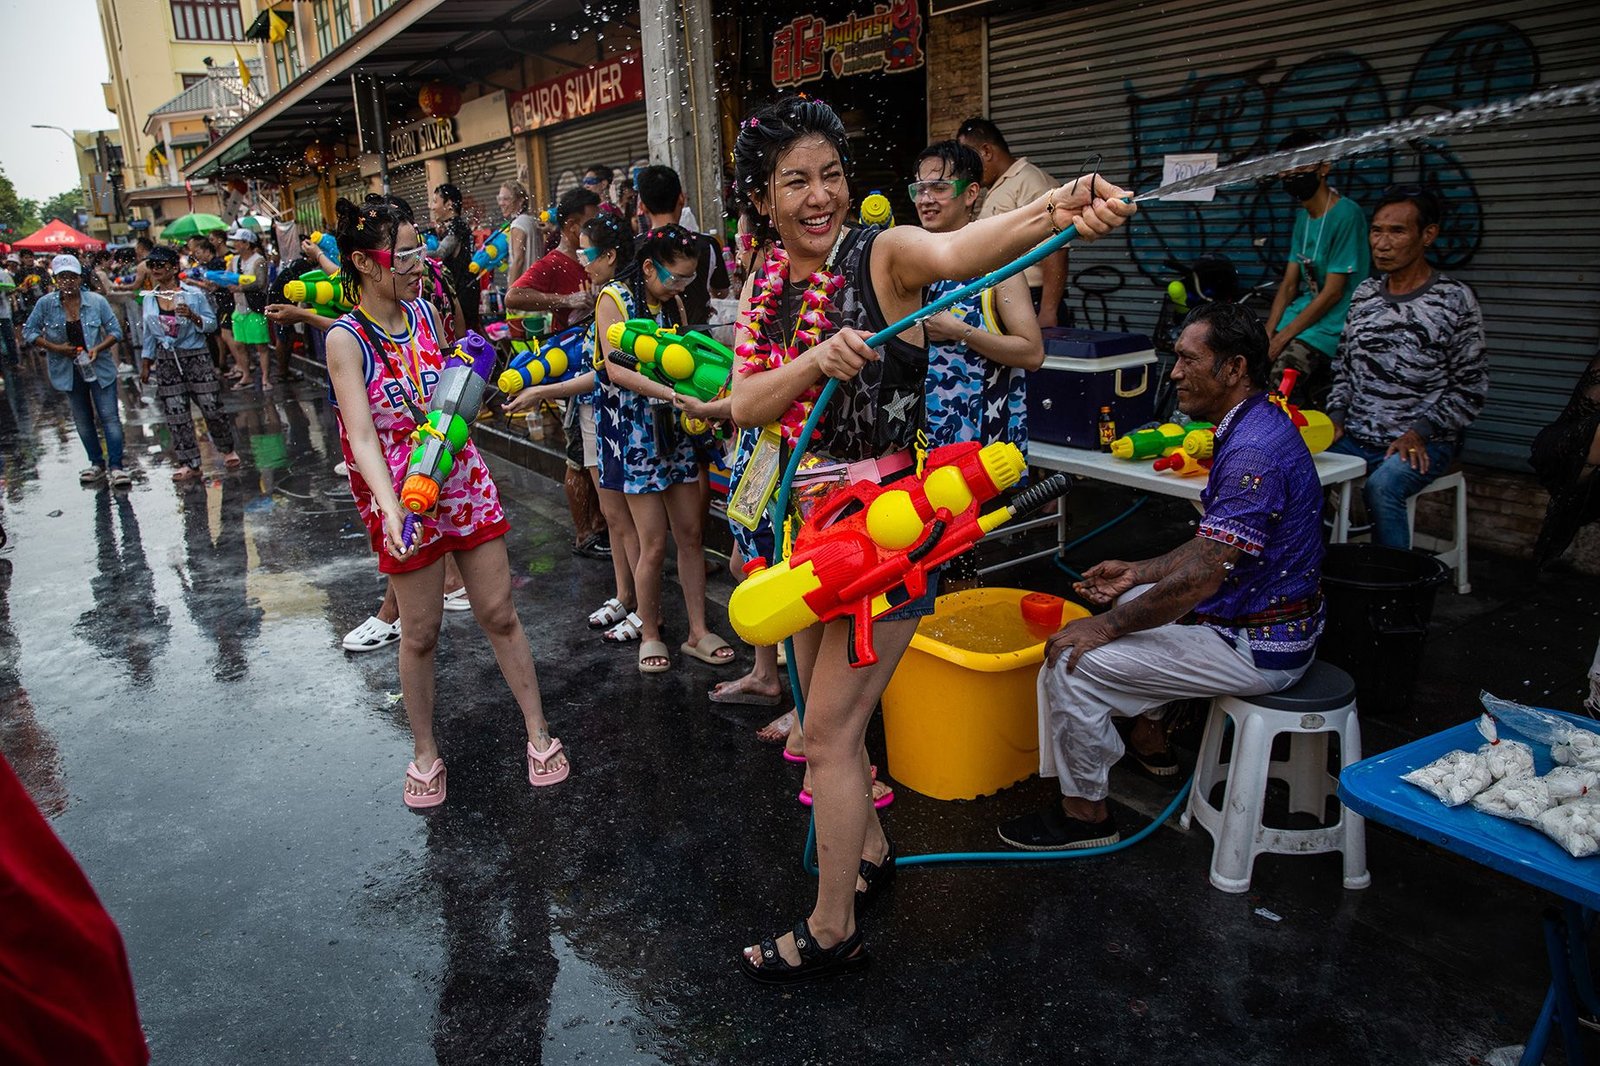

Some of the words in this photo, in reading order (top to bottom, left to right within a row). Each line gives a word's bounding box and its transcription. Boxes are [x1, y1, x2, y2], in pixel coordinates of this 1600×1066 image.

[522, 83, 562, 126] EURO
[565, 63, 624, 116] SILVER
[386, 131, 417, 161] CORN
[418, 118, 454, 152] SILVER
